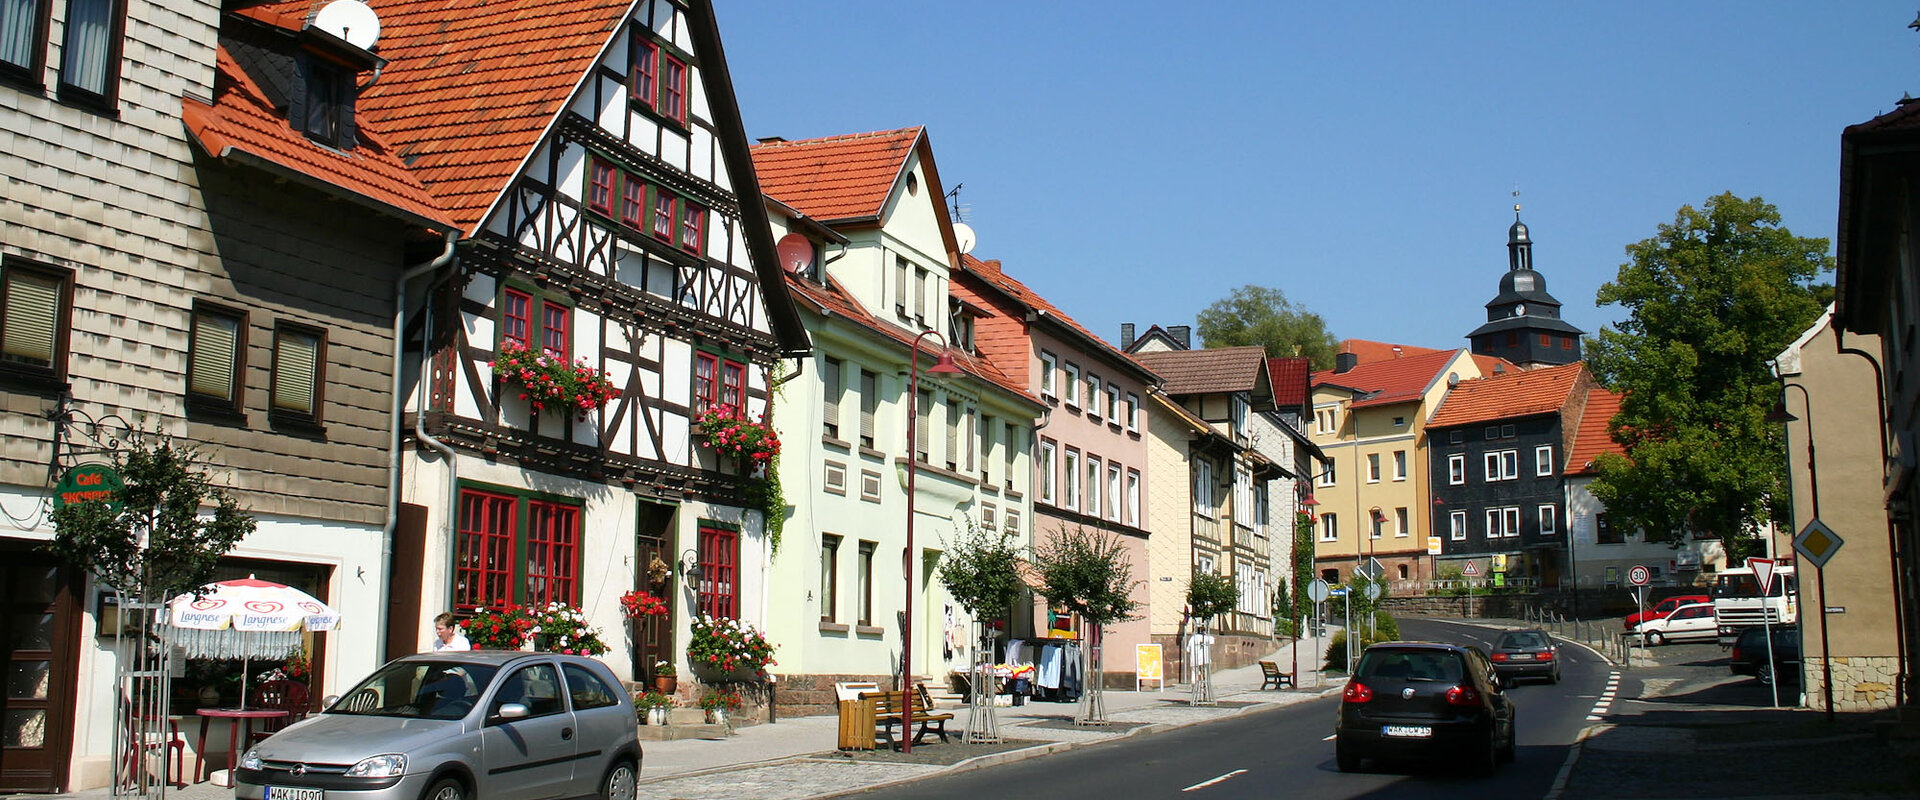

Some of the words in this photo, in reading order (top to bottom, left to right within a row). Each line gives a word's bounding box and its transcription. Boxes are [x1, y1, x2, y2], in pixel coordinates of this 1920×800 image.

[76, 473, 102, 486] Café
[1633, 571, 1645, 580] 30
[180, 610, 220, 626] Langnese
[242, 614, 288, 629] Langnese
[271, 788, 289, 799] WAK
